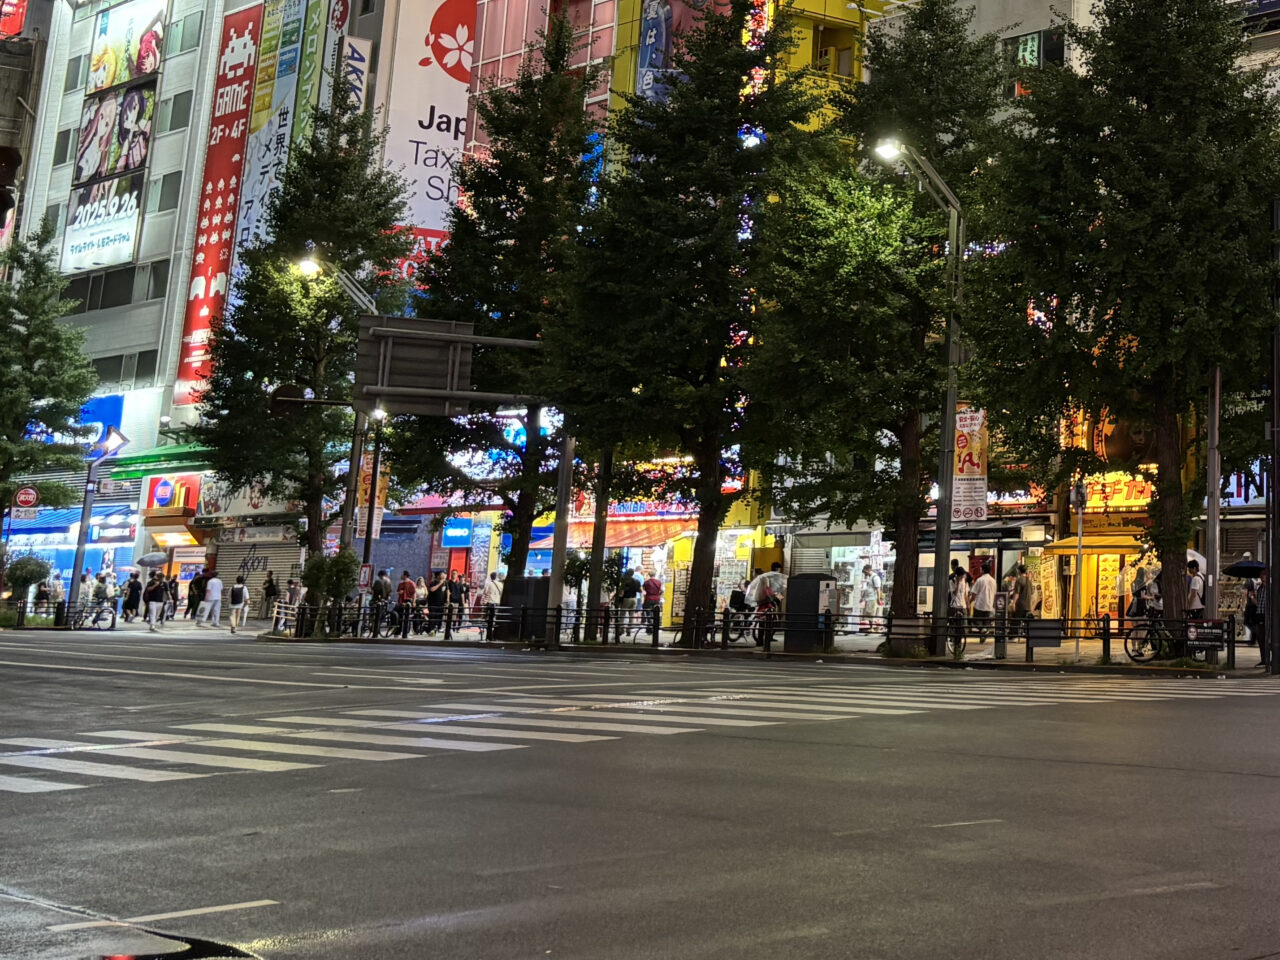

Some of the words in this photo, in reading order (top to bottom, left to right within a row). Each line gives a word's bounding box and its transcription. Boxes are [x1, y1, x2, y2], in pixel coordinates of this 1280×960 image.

[214, 79, 250, 118] GAME
[209, 125, 224, 146] 2F
[230, 118, 247, 139] 4F
[73, 190, 139, 228] 2025.9.26
